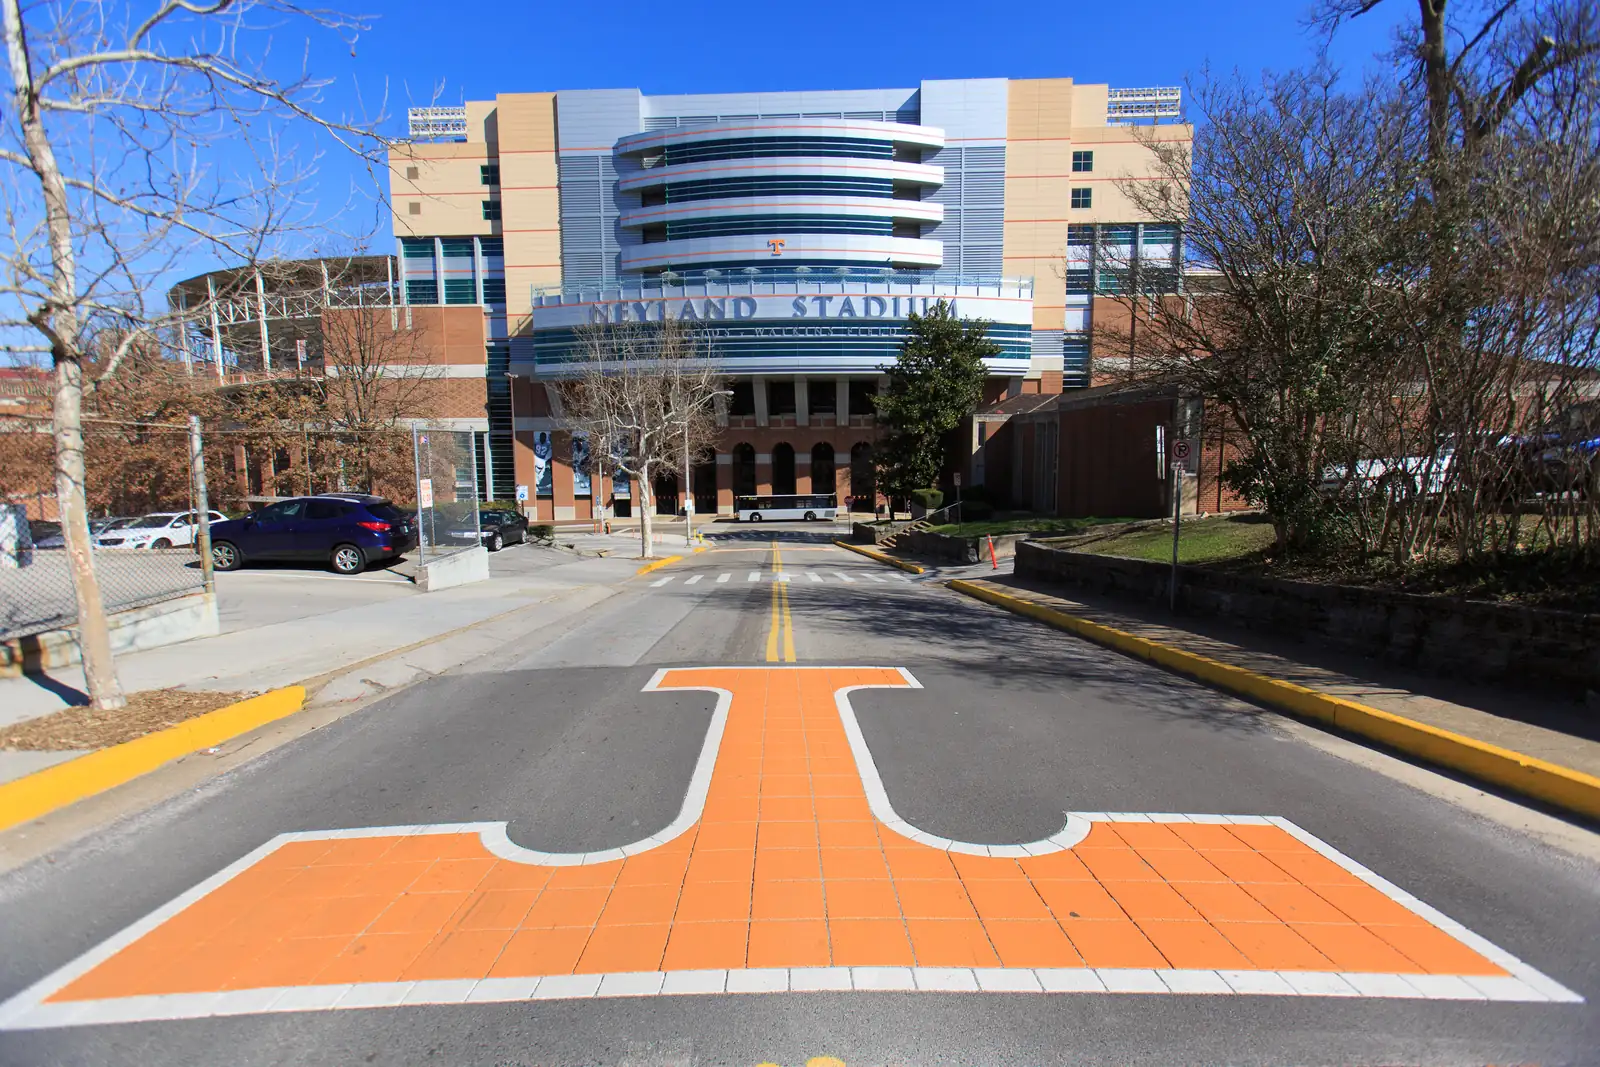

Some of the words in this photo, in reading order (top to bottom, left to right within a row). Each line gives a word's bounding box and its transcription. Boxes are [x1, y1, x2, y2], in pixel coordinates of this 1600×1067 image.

[768, 239, 785, 256] T
[588, 296, 758, 325] NEYLAND
[846, 326, 898, 337] FIELD
[535, 444, 548, 457] 92
[0, 666, 1584, 1029] T
